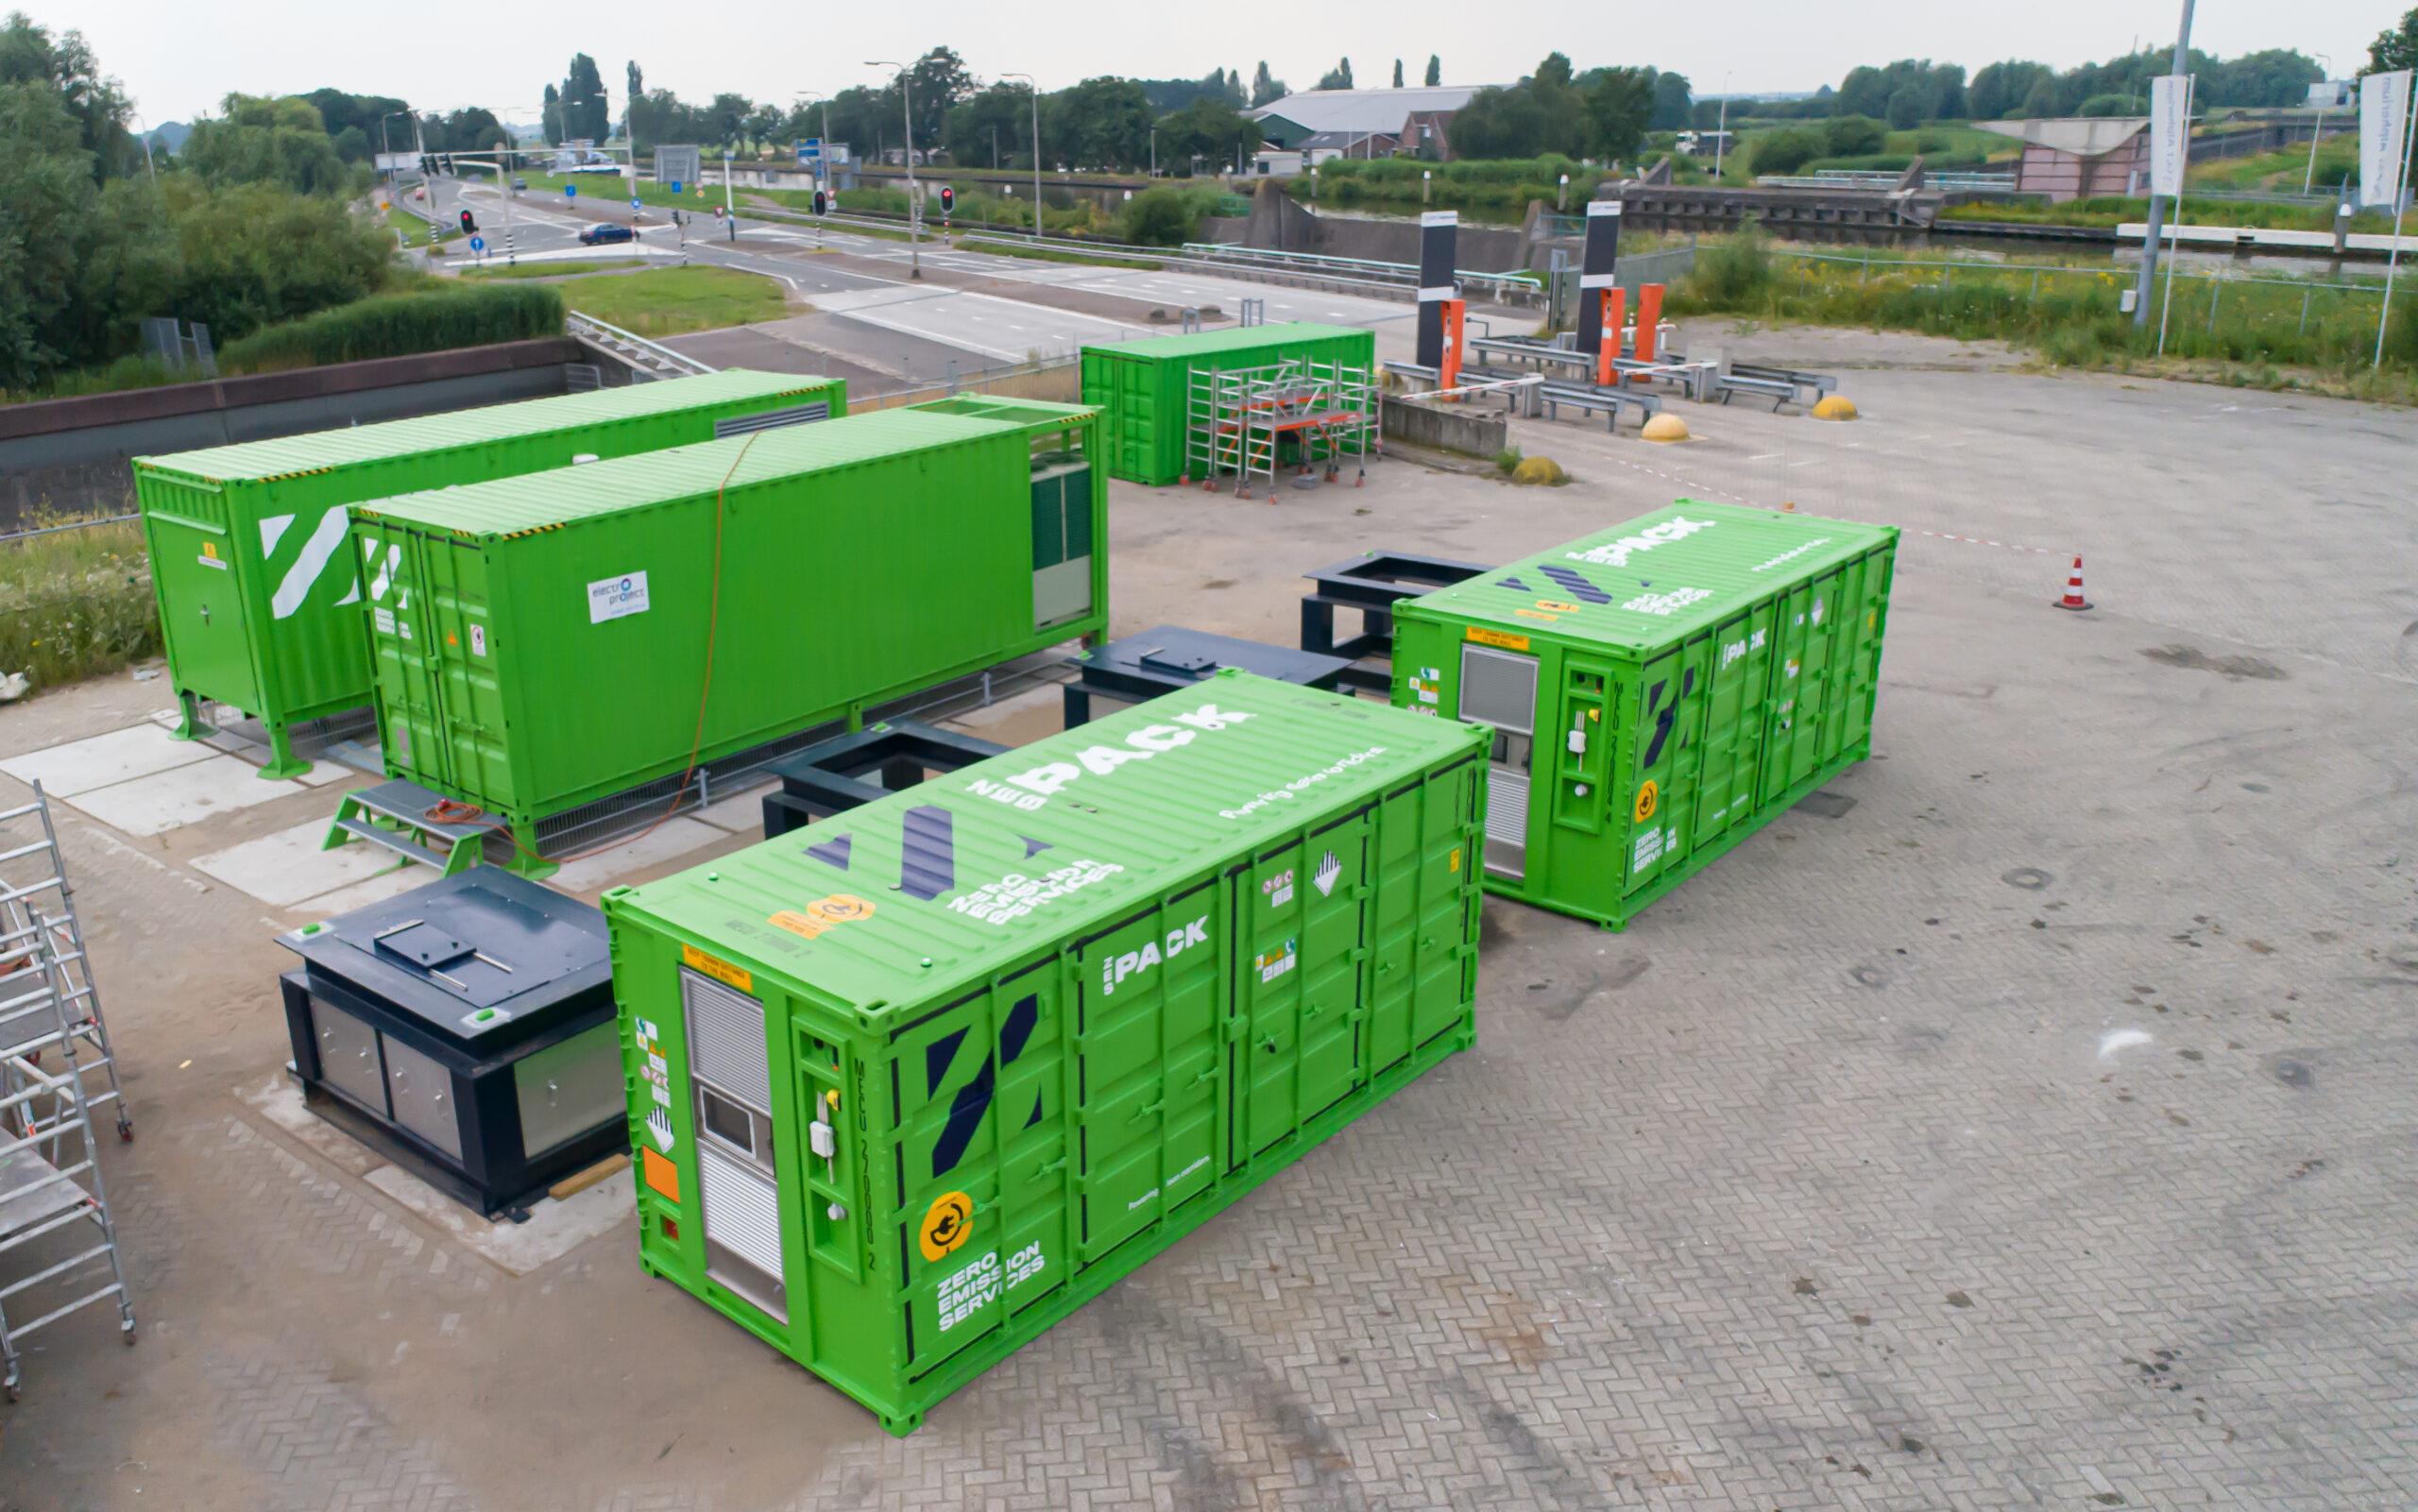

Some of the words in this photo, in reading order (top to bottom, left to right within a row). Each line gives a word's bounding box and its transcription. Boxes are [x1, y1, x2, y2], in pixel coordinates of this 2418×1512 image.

[1586, 517, 1716, 552] PACK
[1005, 704, 1258, 795] PACK
[946, 873, 1028, 913] ZERO
[1115, 914, 1209, 984] PACK
[1102, 956, 1115, 996] ZES
[937, 1251, 997, 1300] ZERO
